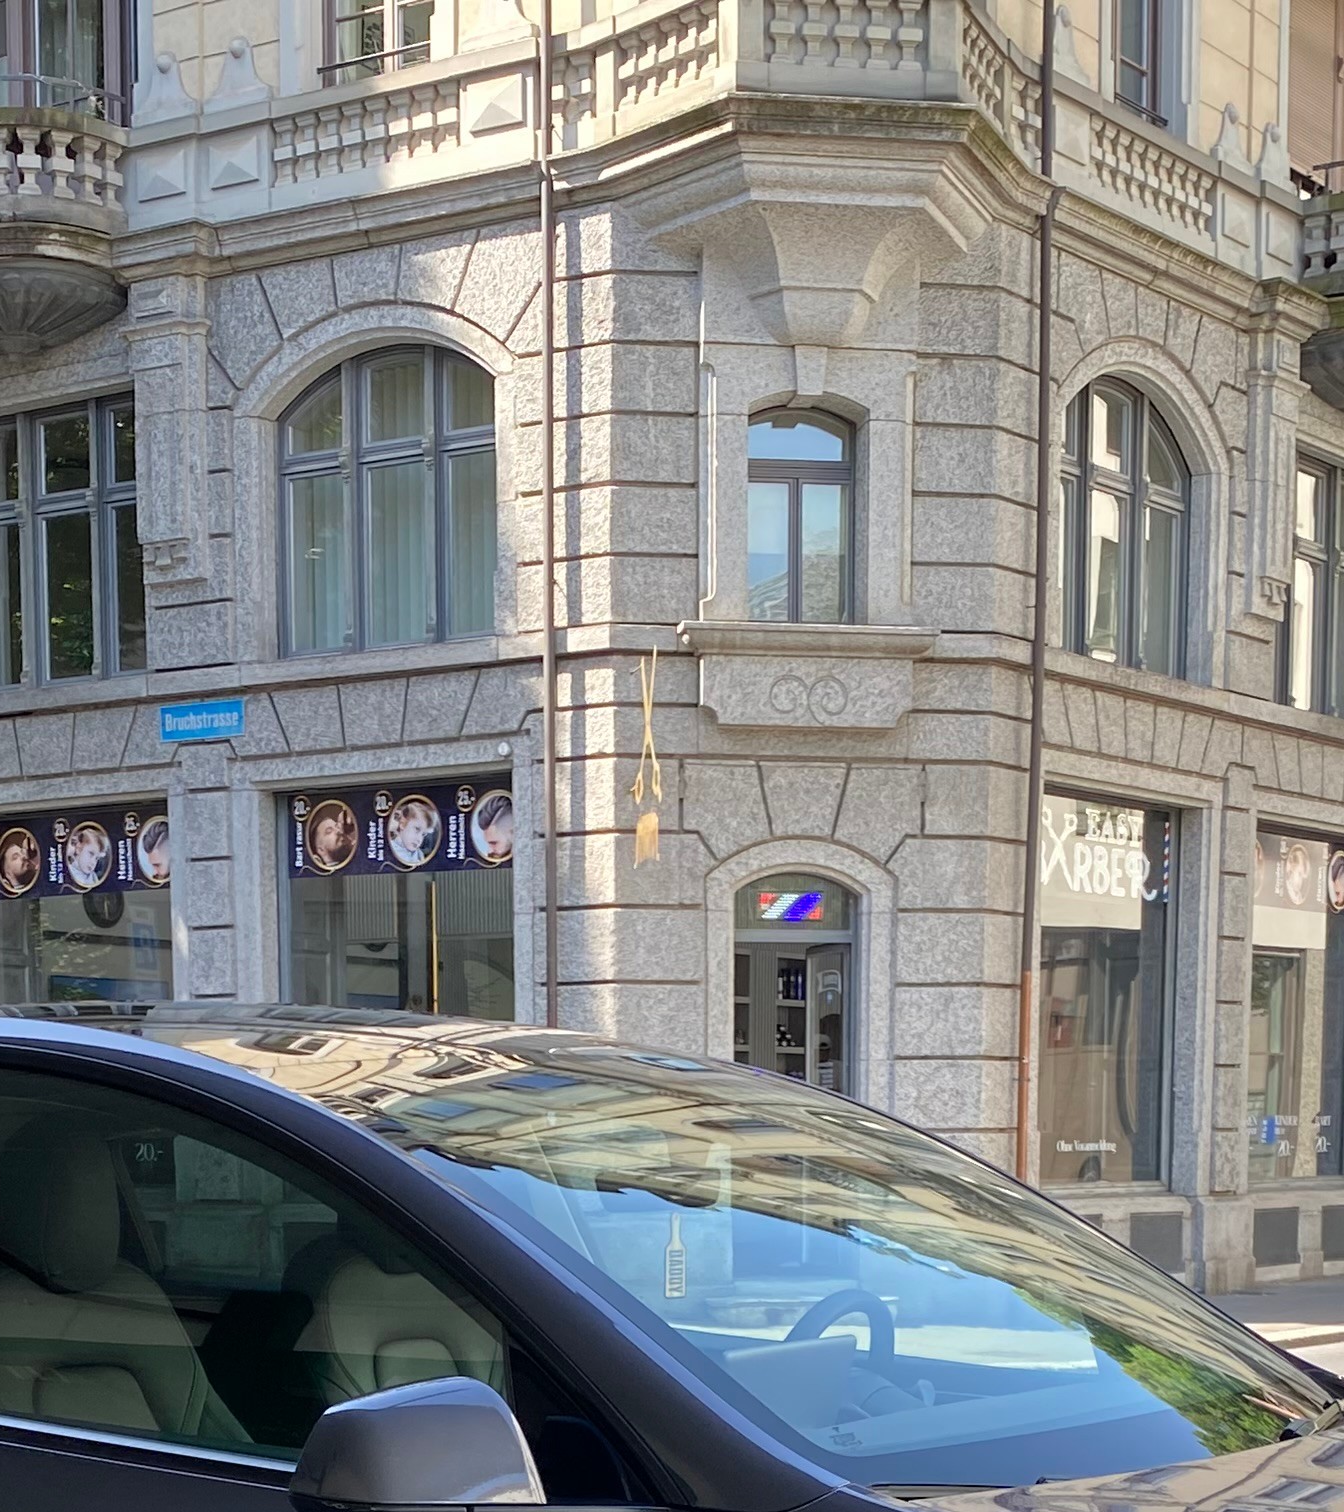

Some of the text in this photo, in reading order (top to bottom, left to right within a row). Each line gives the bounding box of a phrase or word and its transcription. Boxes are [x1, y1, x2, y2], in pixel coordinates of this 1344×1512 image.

[165, 711, 239, 732] Bruchstrasse
[367, 820, 376, 858] Kinder
[447, 815, 457, 859] Herren
[1085, 808, 1144, 848] EASY
[118, 840, 126, 880] Herren
[135, 1143, 164, 1162] 20.-
